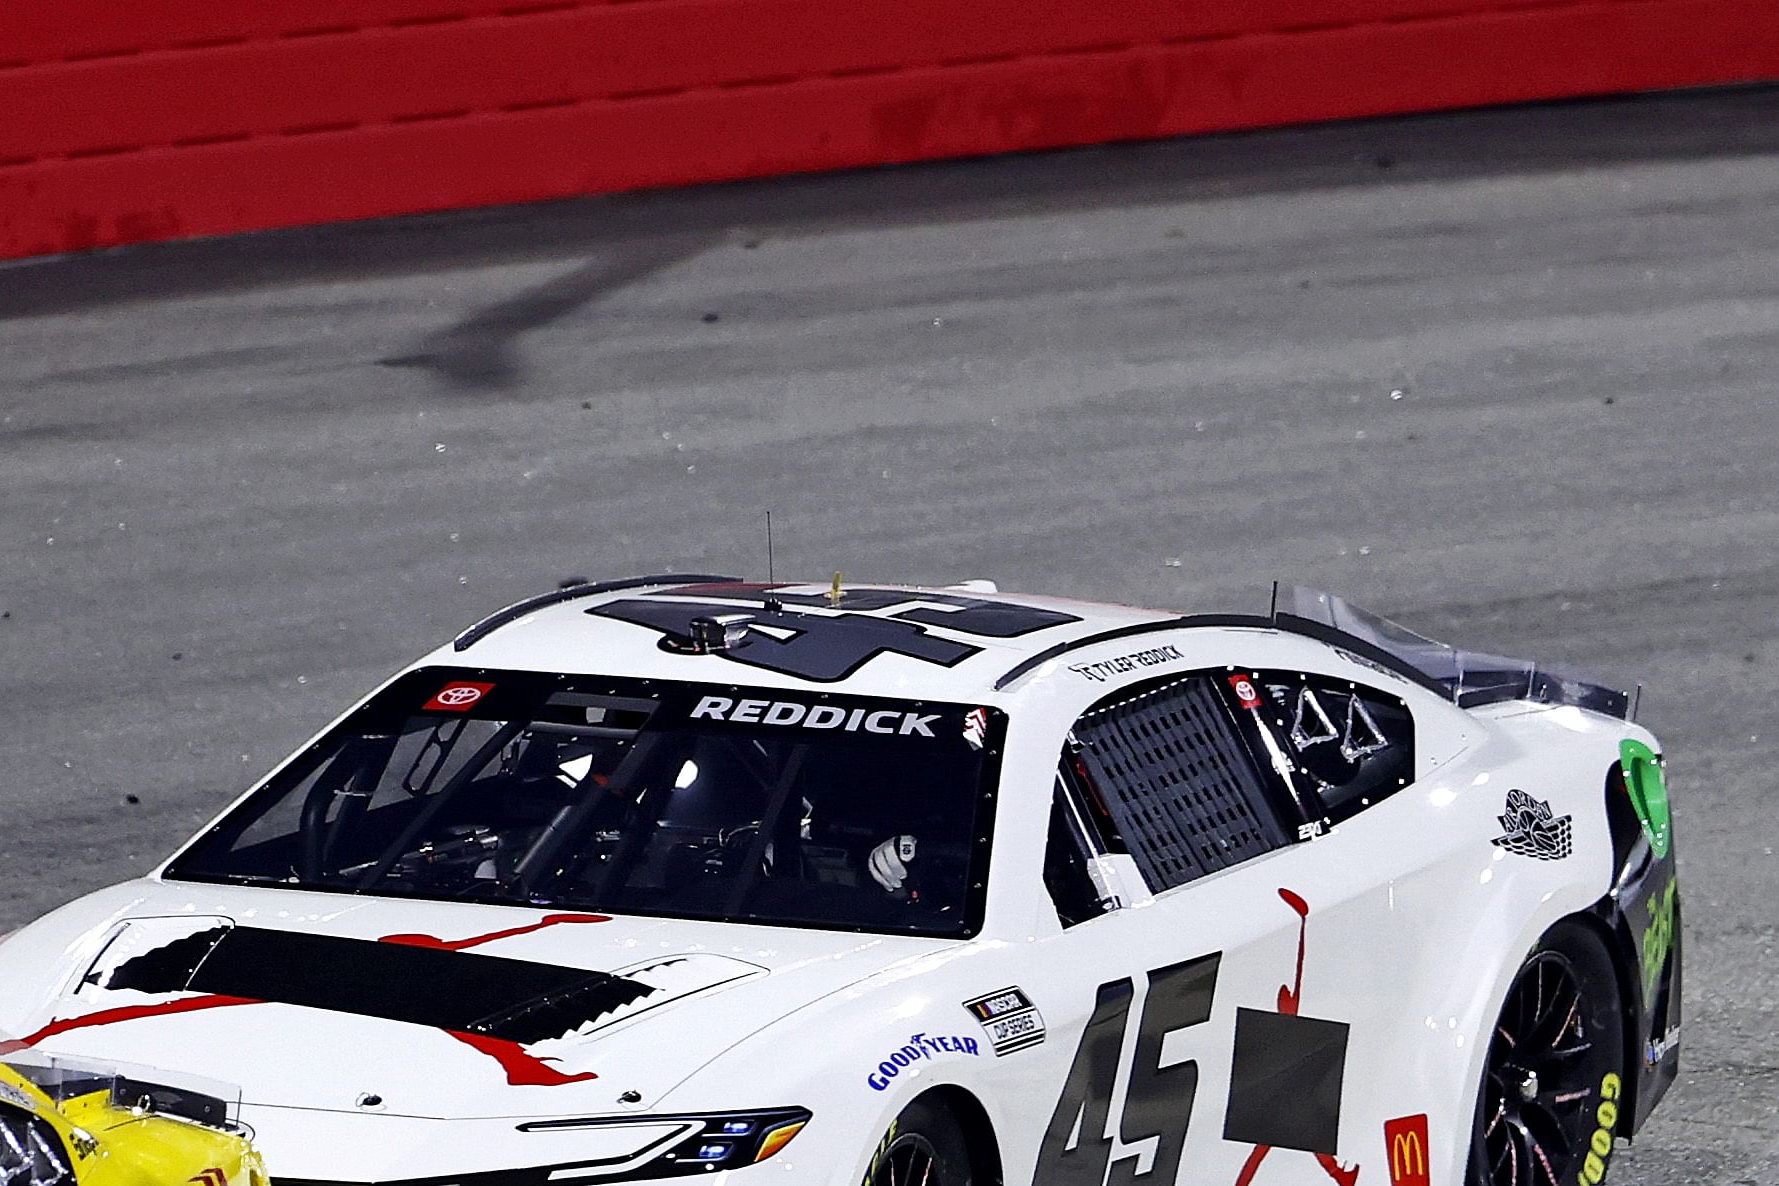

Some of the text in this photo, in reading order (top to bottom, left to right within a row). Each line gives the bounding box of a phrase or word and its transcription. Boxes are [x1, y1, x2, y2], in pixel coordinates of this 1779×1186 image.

[1091, 658, 1137, 677] TYLER
[1128, 644, 1185, 667] REDDICK
[690, 697, 942, 737] REDDICK
[985, 993, 1023, 1015] NASCAR
[993, 1014, 1035, 1040] CUP SERIES
[868, 1033, 979, 1091] GOODYEAR
